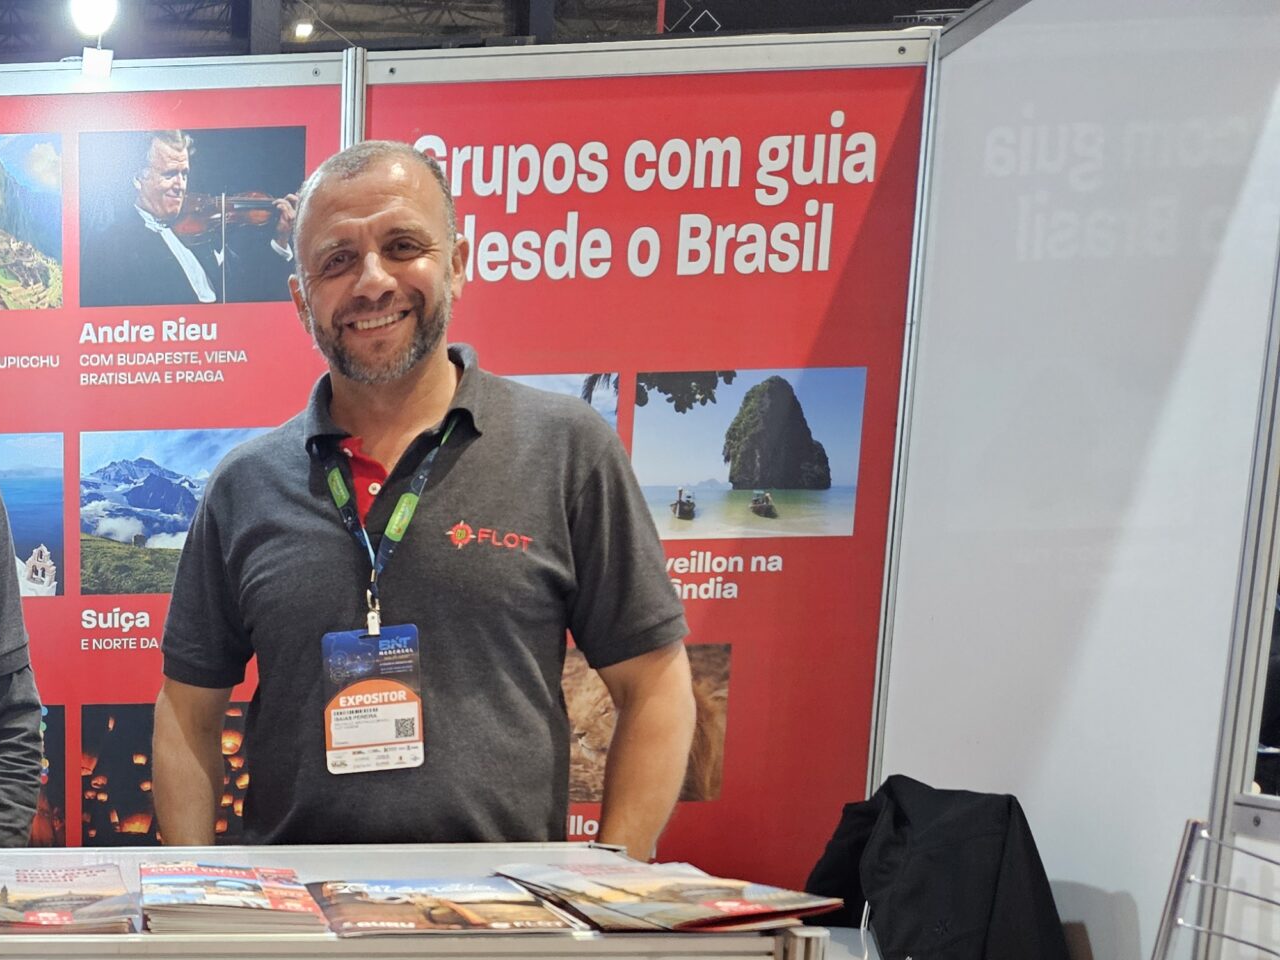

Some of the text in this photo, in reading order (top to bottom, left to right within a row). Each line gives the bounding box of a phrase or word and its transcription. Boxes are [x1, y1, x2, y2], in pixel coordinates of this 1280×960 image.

[624, 135, 742, 193] com
[754, 110, 878, 206] guia
[627, 226, 661, 278] o
[676, 199, 835, 276] Brasil
[79, 317, 218, 344] Andre Rieu
[79, 350, 248, 367] COM BUDAPESTE, VIENA
[79, 369, 224, 386] BRATISLAVA E PRAGA
[477, 527, 534, 553] FLOT
[665, 550, 783, 574] veillon na
[670, 576, 738, 599] ândia
[81, 607, 150, 633] Suíça
[81, 637, 159, 651] E NORTE DA
[339, 690, 407, 707] EXPOSITOR
